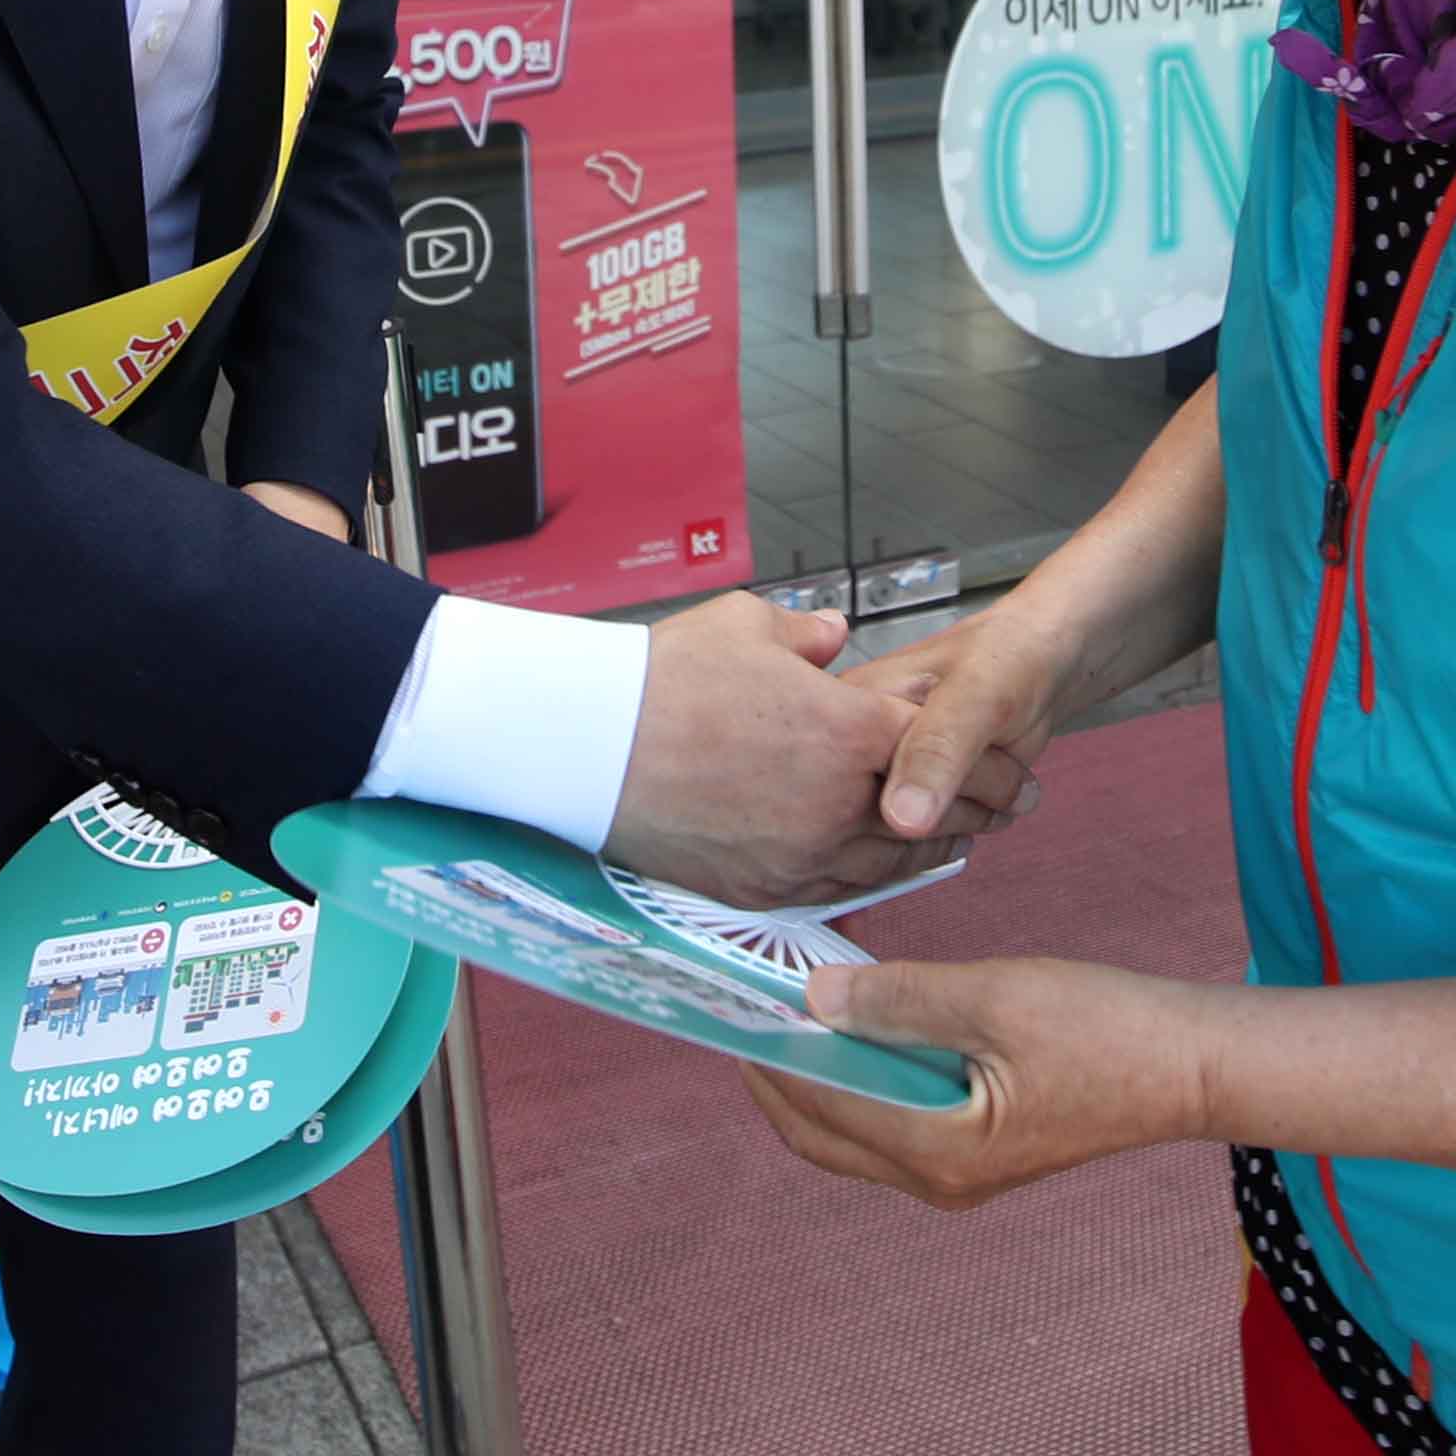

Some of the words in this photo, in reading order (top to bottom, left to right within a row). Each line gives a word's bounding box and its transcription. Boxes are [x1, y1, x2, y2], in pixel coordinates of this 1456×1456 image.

[385, 22, 553, 94] ,500원
[982, 34, 1276, 276] ON
[586, 221, 687, 291] 100GB
[573, 256, 702, 335] +무제한
[469, 359, 515, 394] ON
[417, 405, 518, 468] 디오
[690, 528, 720, 558] kt
[22, 1070, 121, 1108] 아끼자!
[44, 1101, 140, 1137] 에너지,
